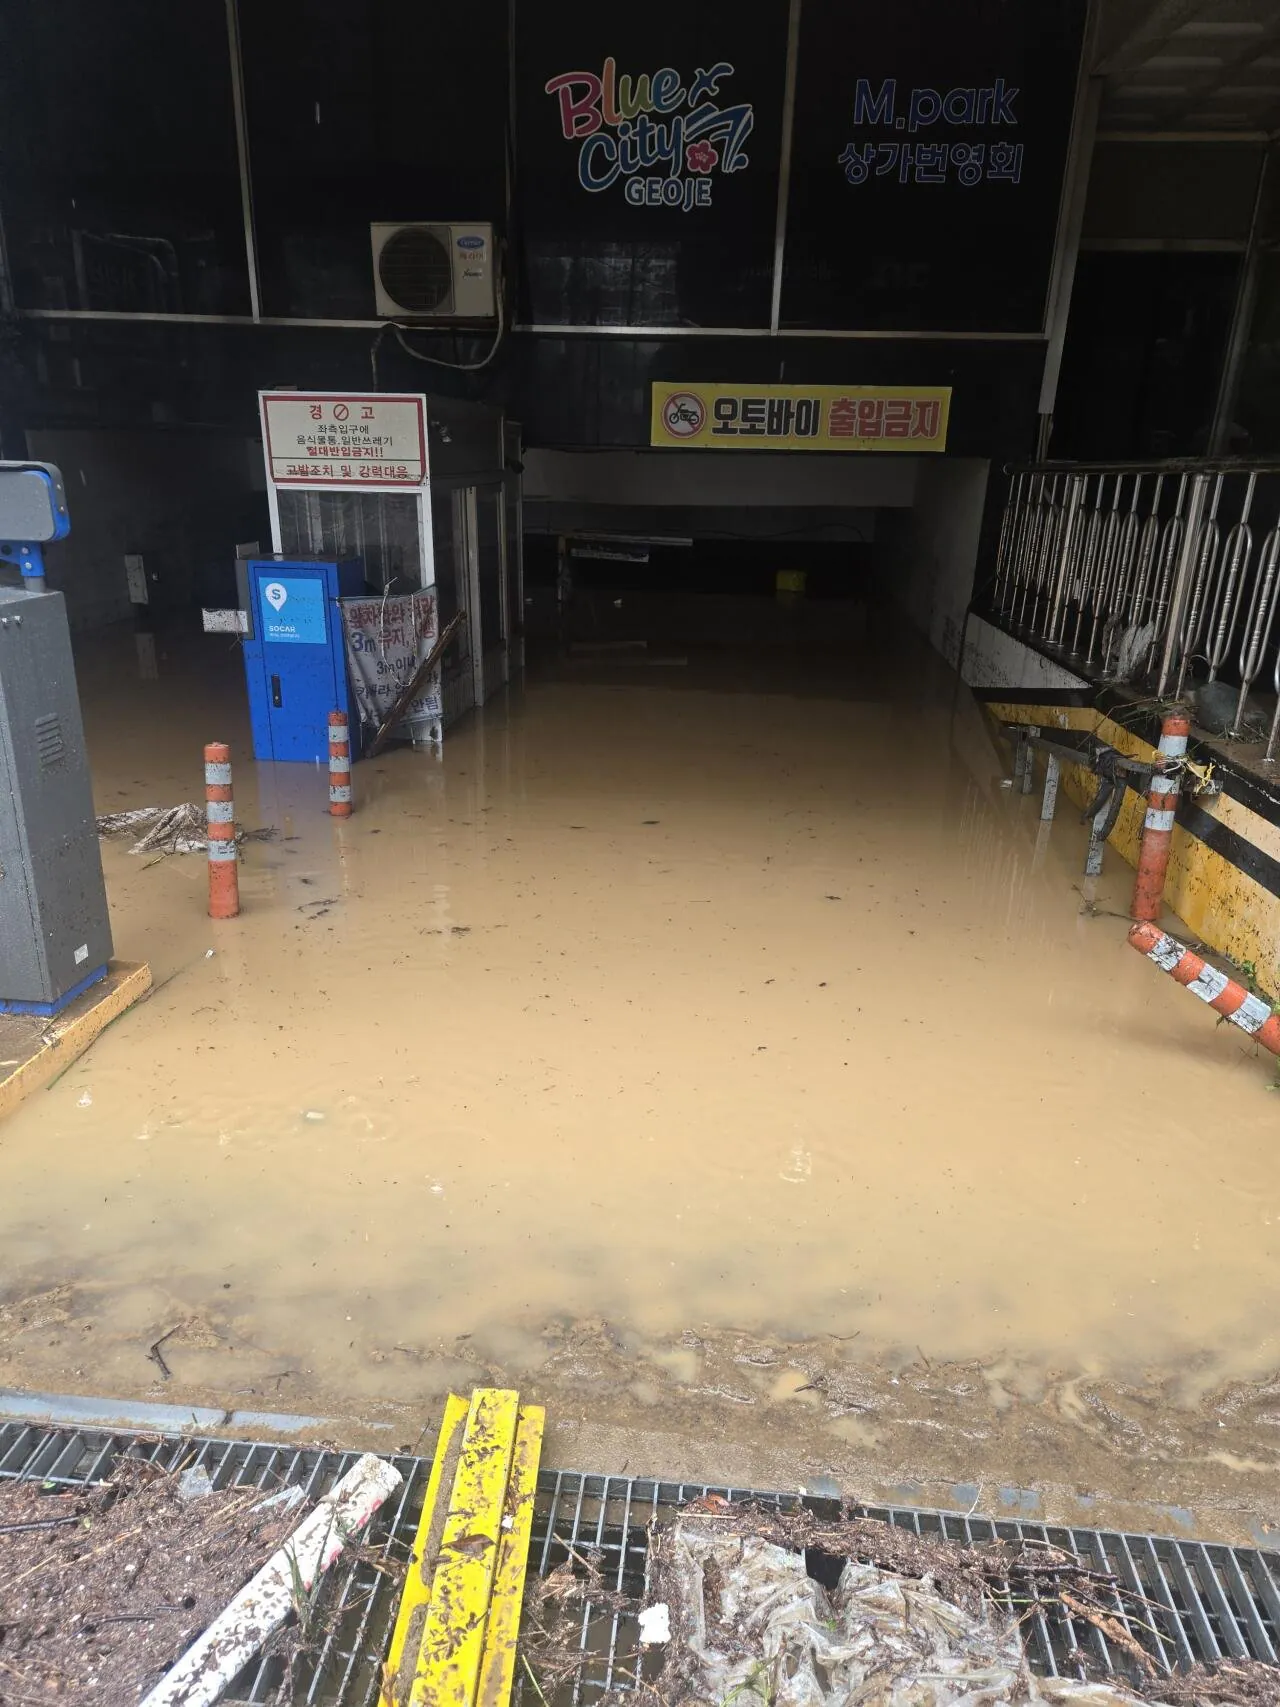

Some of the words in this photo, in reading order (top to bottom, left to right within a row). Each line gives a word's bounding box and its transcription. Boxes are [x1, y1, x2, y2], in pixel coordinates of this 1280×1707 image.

[545, 57, 685, 139] Blue
[853, 78, 1020, 132] M.park
[579, 115, 685, 192] City
[838, 142, 1024, 185] 상가번영회
[624, 177, 713, 211] GEOJE
[317, 424, 369, 434] 좌측입구에
[711, 397, 821, 437] 오토바이
[829, 397, 942, 438] 출입금지
[286, 464, 333, 477] 고발조치
[341, 465, 352, 477] 및
[359, 465, 408, 479] 강력대응
[268, 625, 296, 633] SOCAR
[351, 630, 376, 652] 3m
